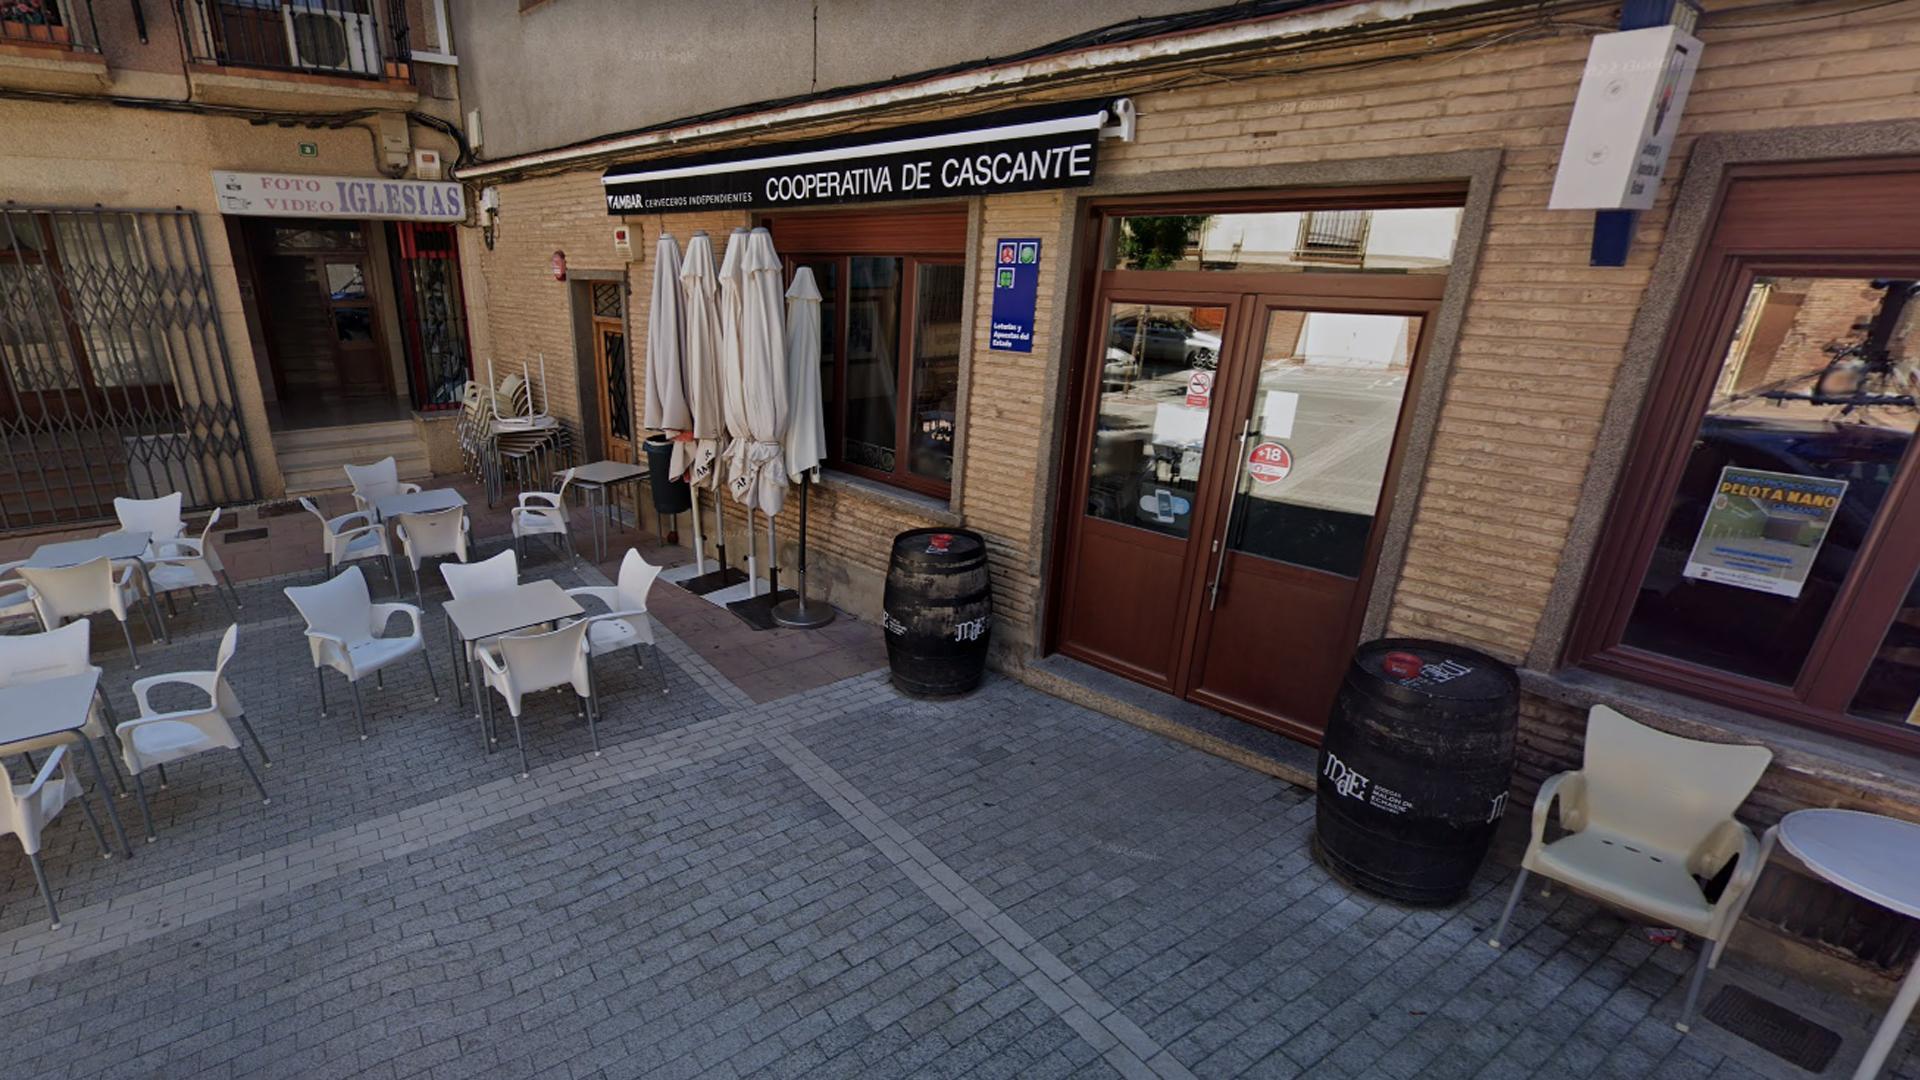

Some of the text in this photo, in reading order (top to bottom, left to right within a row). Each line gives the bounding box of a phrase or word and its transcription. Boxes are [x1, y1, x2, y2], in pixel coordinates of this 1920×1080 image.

[765, 143, 1092, 201] COOPERATIVA DE CASCANTE
[260, 176, 461, 217] FOTO IGLESIAS
[264, 197, 334, 213] VIDEO
[688, 192, 753, 206] INDEPENDIENTES
[1257, 447, 1282, 462] +18
[1720, 481, 1783, 502] PELOTA
[1786, 490, 1837, 509] MANO
